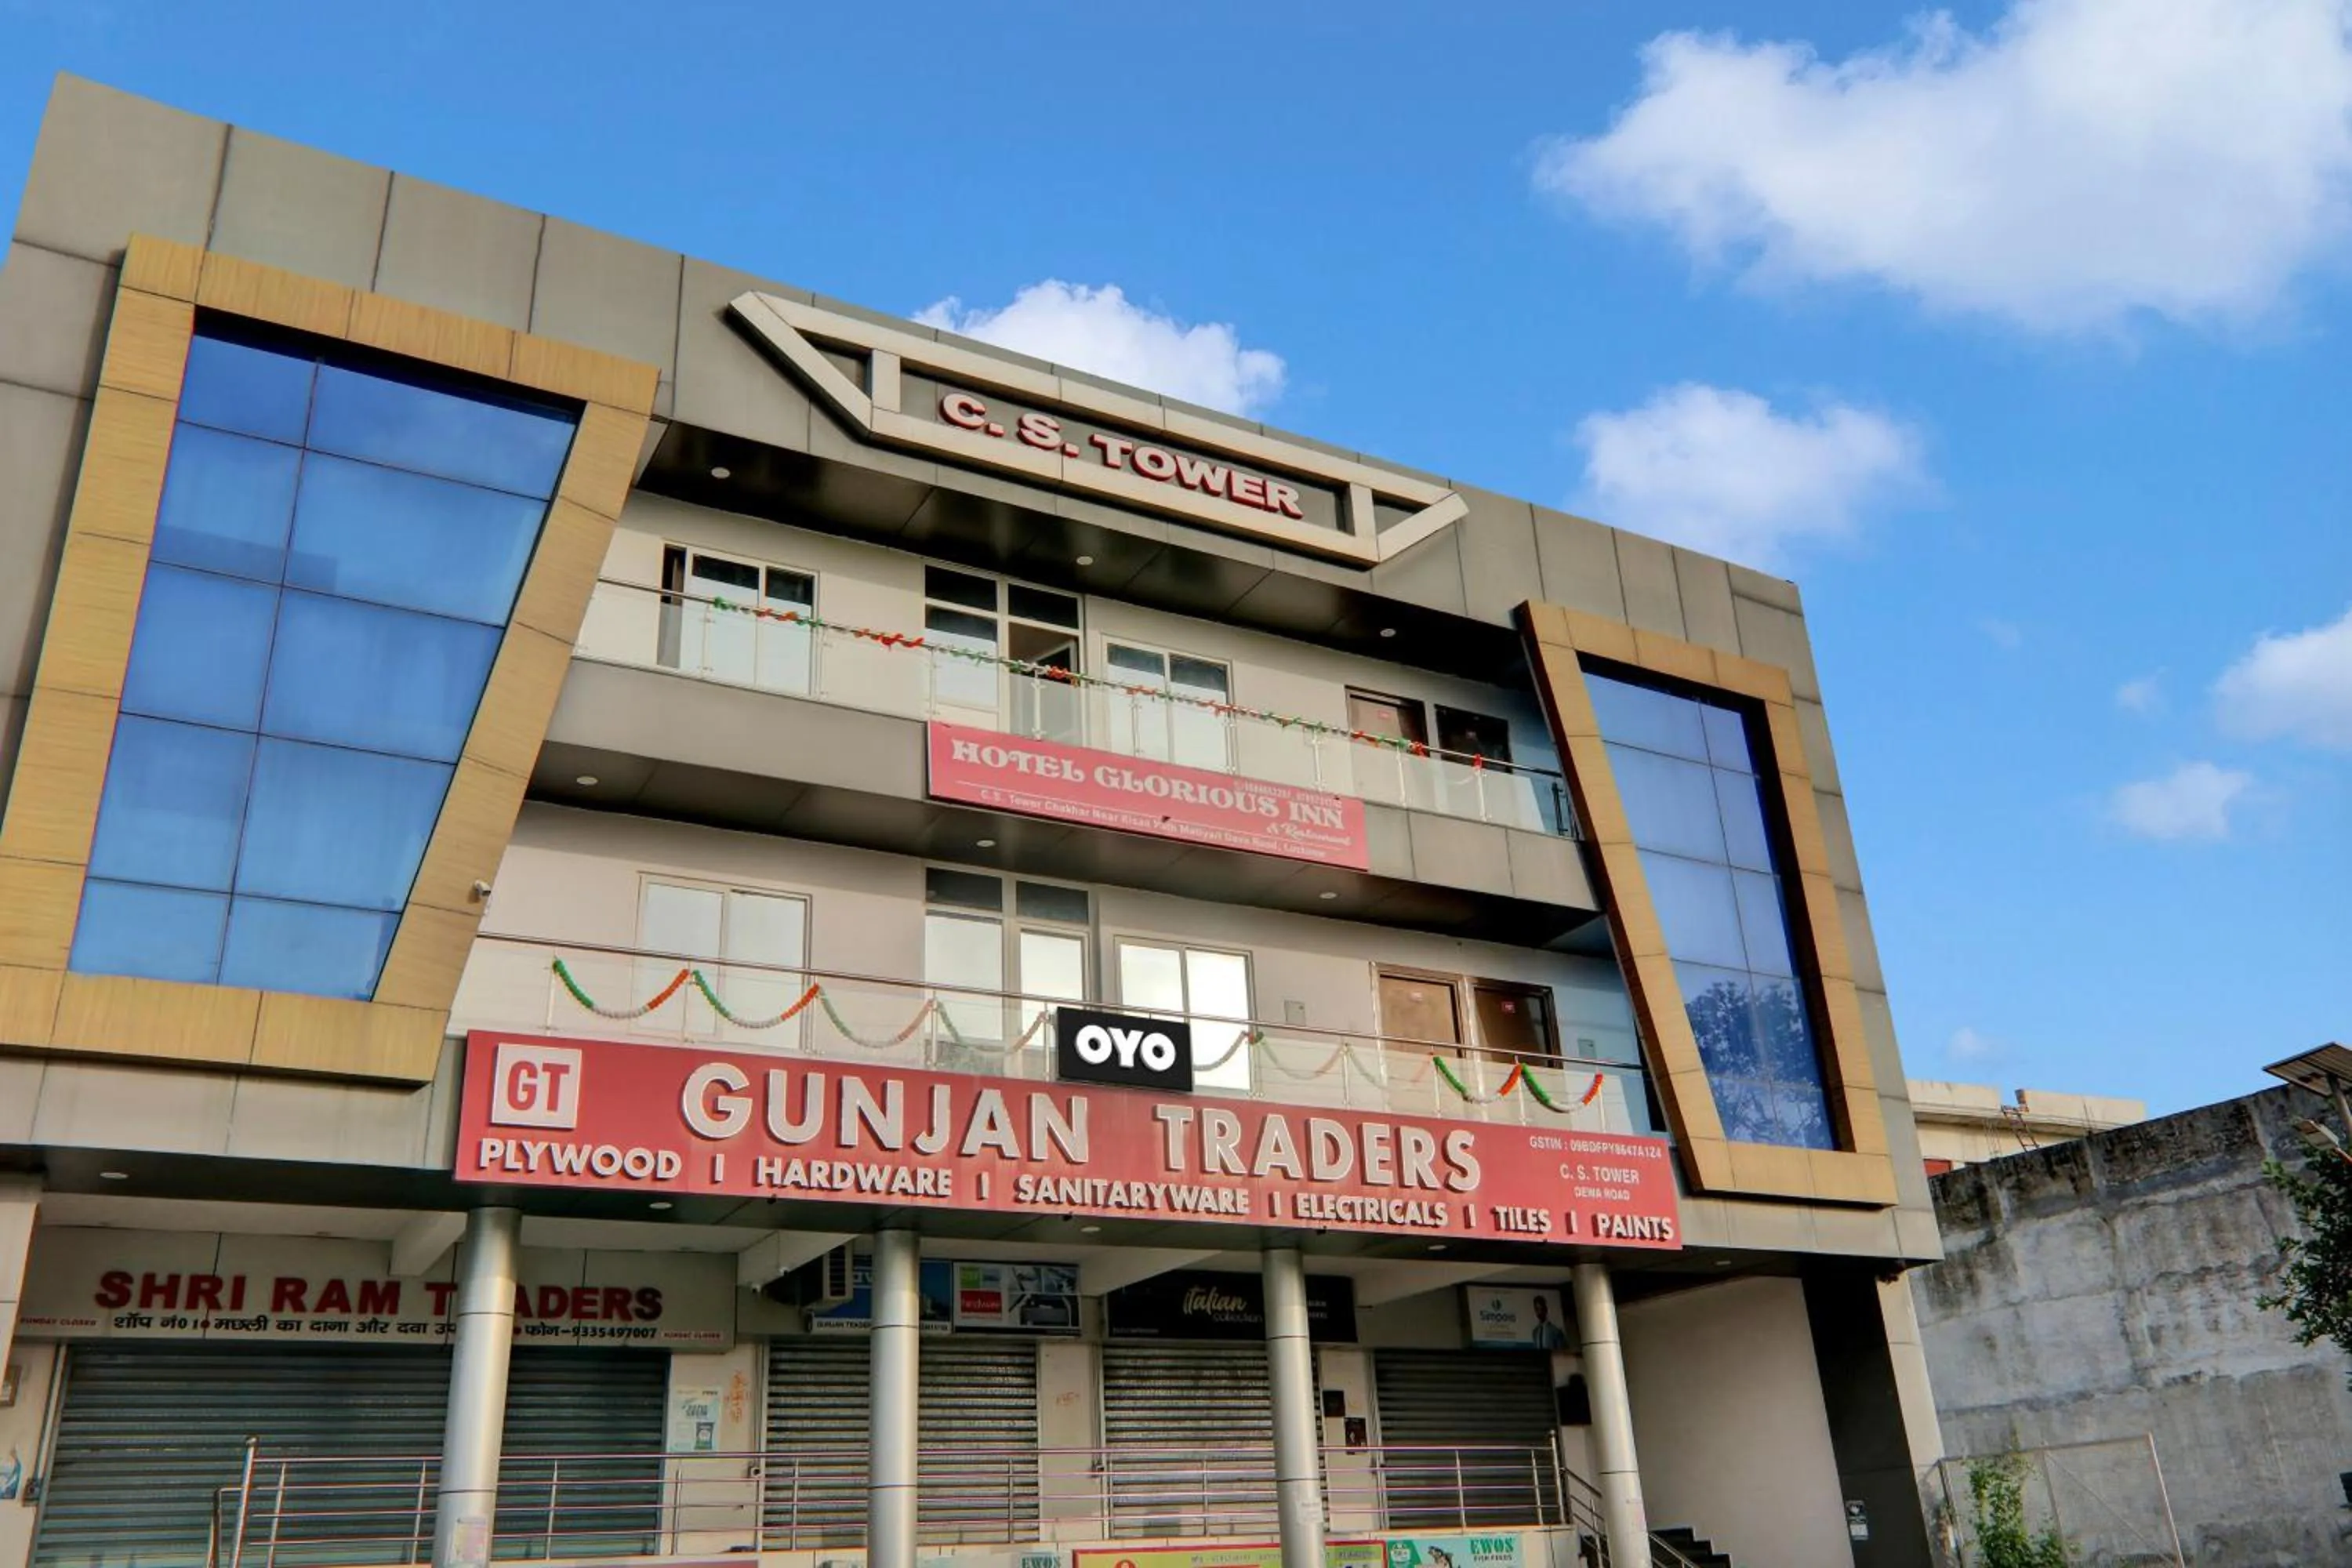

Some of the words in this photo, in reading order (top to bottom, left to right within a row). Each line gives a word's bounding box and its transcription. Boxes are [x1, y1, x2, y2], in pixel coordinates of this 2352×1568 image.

[941, 392, 1004, 437] C.
[1018, 412, 1080, 458] S.
[1090, 434, 1304, 519] TOWER
[951, 739, 1085, 782] HOTEL
[1094, 765, 1279, 819] GLORIOUS
[1288, 798, 1345, 829] INN
[1075, 1024, 1176, 1073] OYO
[506, 1060, 570, 1112] GT
[681, 1062, 1088, 1164] GUNJAN
[1155, 1103, 1481, 1192] TRADERS
[480, 1138, 682, 1180] PLYWOOD
[757, 1156, 953, 1198] HARDWARE
[1017, 1174, 1250, 1215] SANITARYWARE
[1293, 1192, 1449, 1229] ELECTRICALS
[1491, 1205, 1552, 1233] TILES
[1595, 1214, 1675, 1241] PAINTS
[1592, 1166, 1640, 1185] TOWER
[94, 1270, 246, 1310] SHRI
[270, 1276, 401, 1315] RAM
[1182, 1285, 1248, 1316] Italian
[214, 1315, 269, 1332] मछली
[275, 1319, 302, 1332] का
[309, 1319, 350, 1333] दाना
[355, 1317, 390, 1334] और
[397, 1322, 428, 1334] दवा
[1470, 1537, 1515, 1555] EWOS
